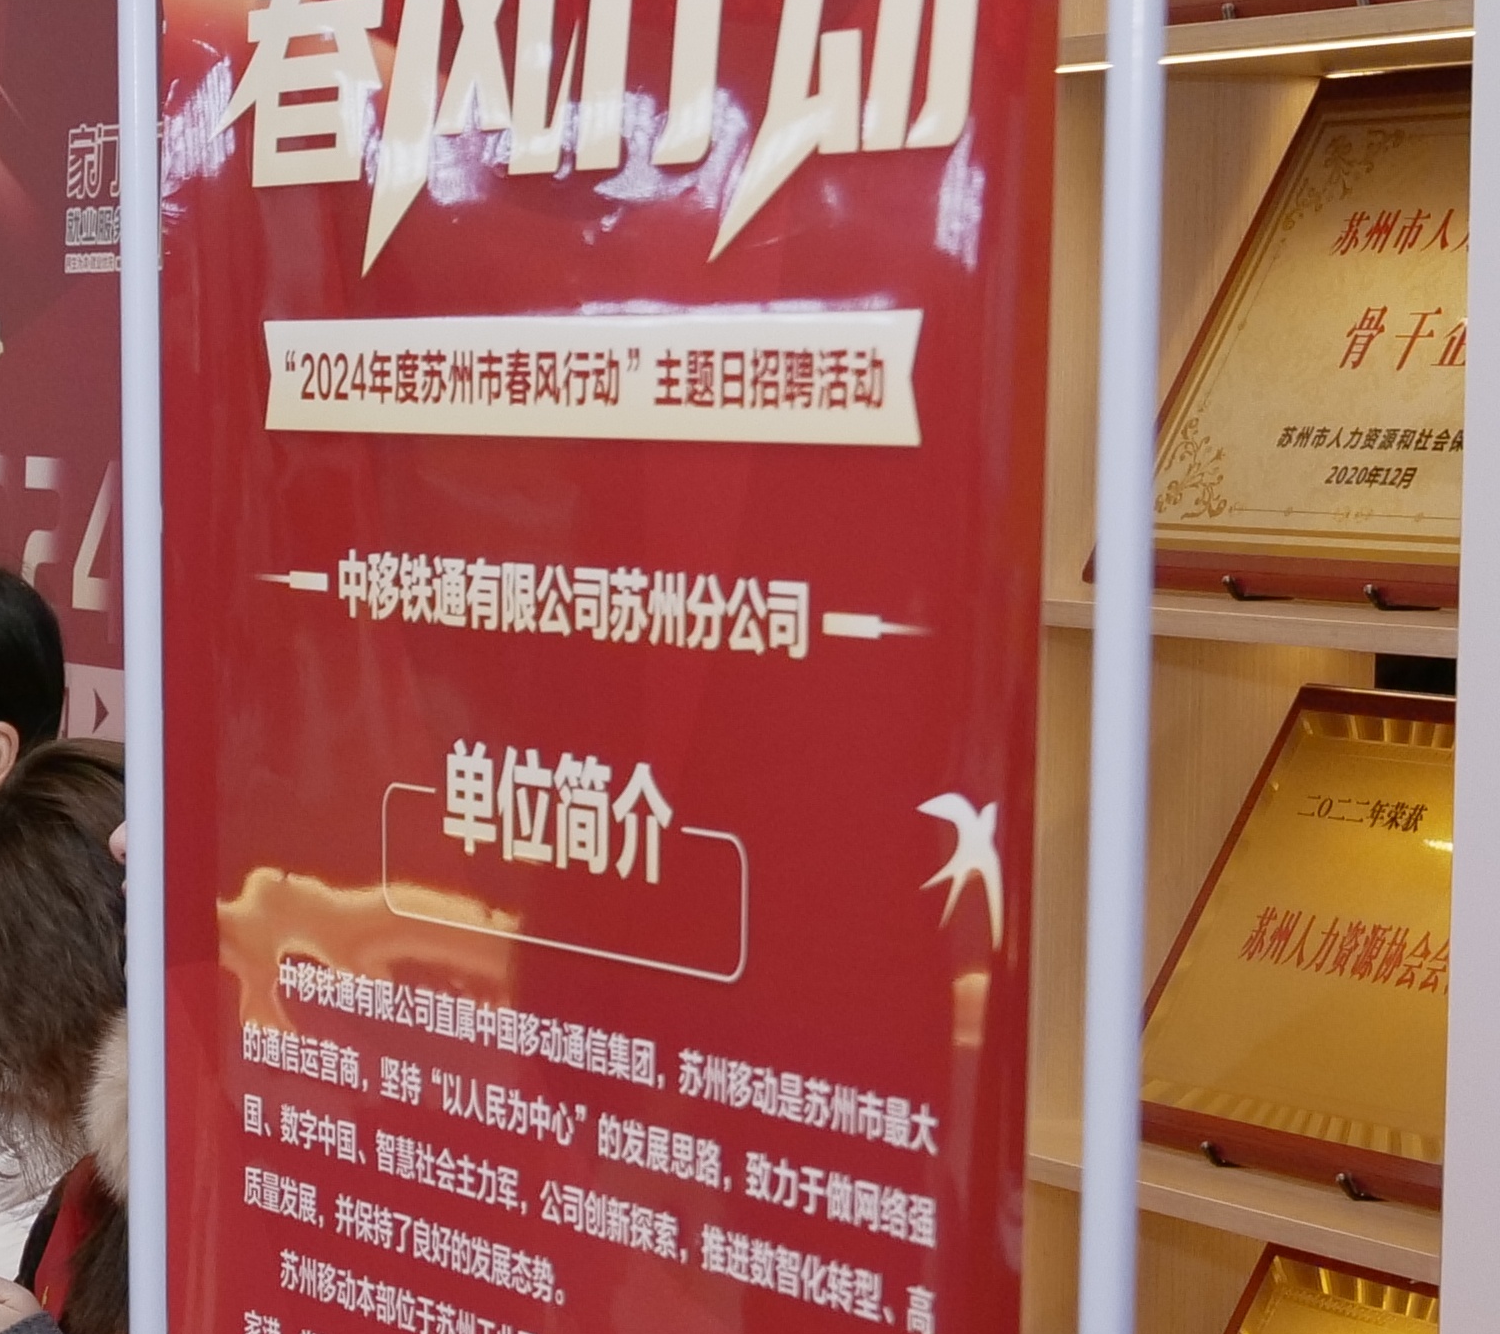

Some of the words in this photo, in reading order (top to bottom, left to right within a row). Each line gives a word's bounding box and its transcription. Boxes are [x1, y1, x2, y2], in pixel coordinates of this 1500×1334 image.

[1324, 465, 1418, 491] 2020年12月
[336, 548, 810, 660] 中移铁通有限公司苏州分公司
[442, 738, 674, 885] 单位简介
[1238, 904, 1451, 995] 苏州人力资源协会会
[243, 1165, 566, 1306] 质量发展，并保持了良好的发展态势。
